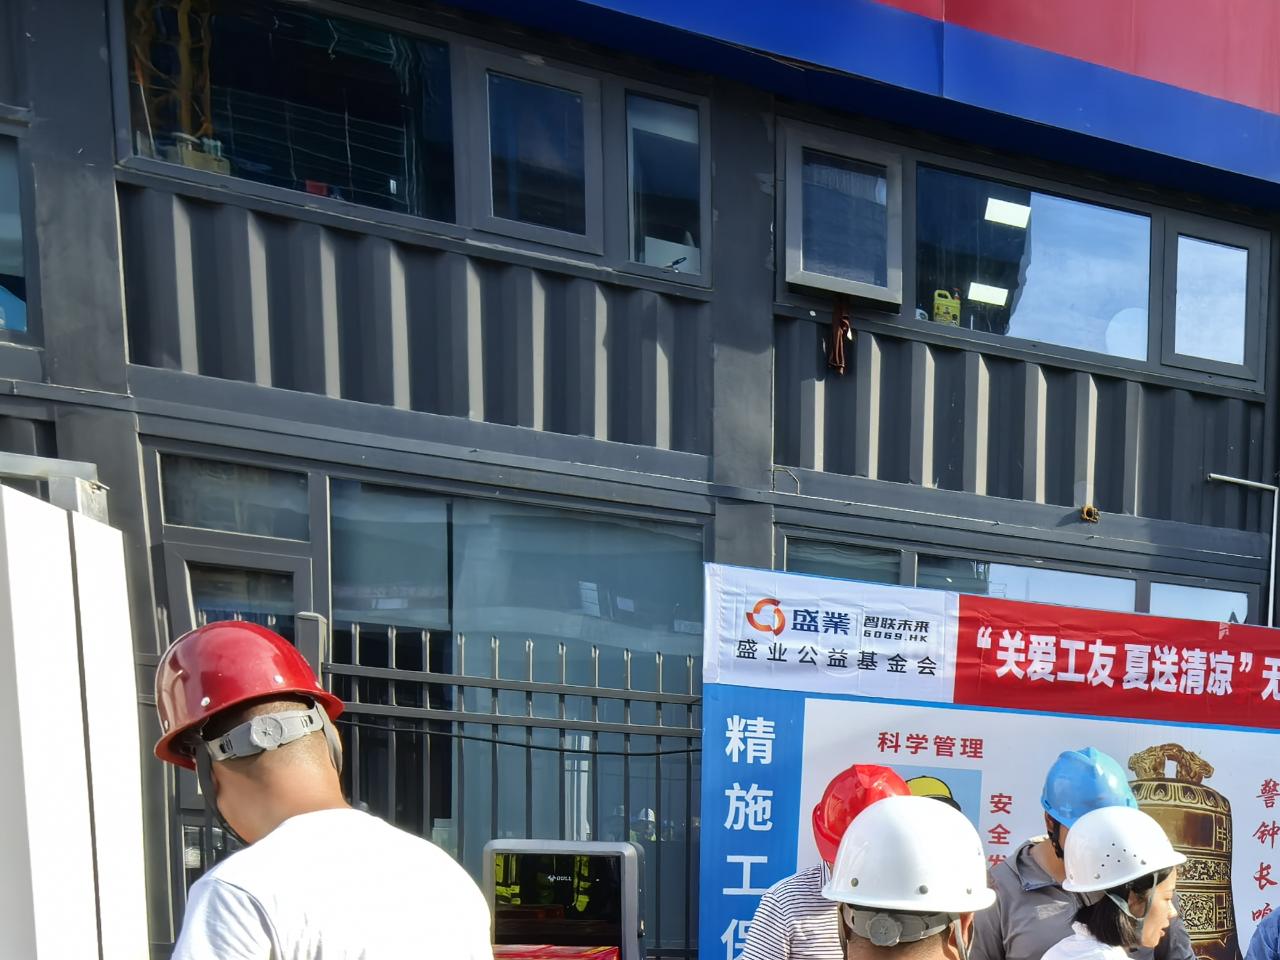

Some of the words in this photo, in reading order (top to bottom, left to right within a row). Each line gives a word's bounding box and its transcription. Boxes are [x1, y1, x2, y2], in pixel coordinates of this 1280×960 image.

[863, 615, 930, 633] 智联未来
[863, 629, 929, 642] 6069.HK
[736, 638, 937, 676] 盛业公益基金会
[877, 731, 985, 759] 科学管理
